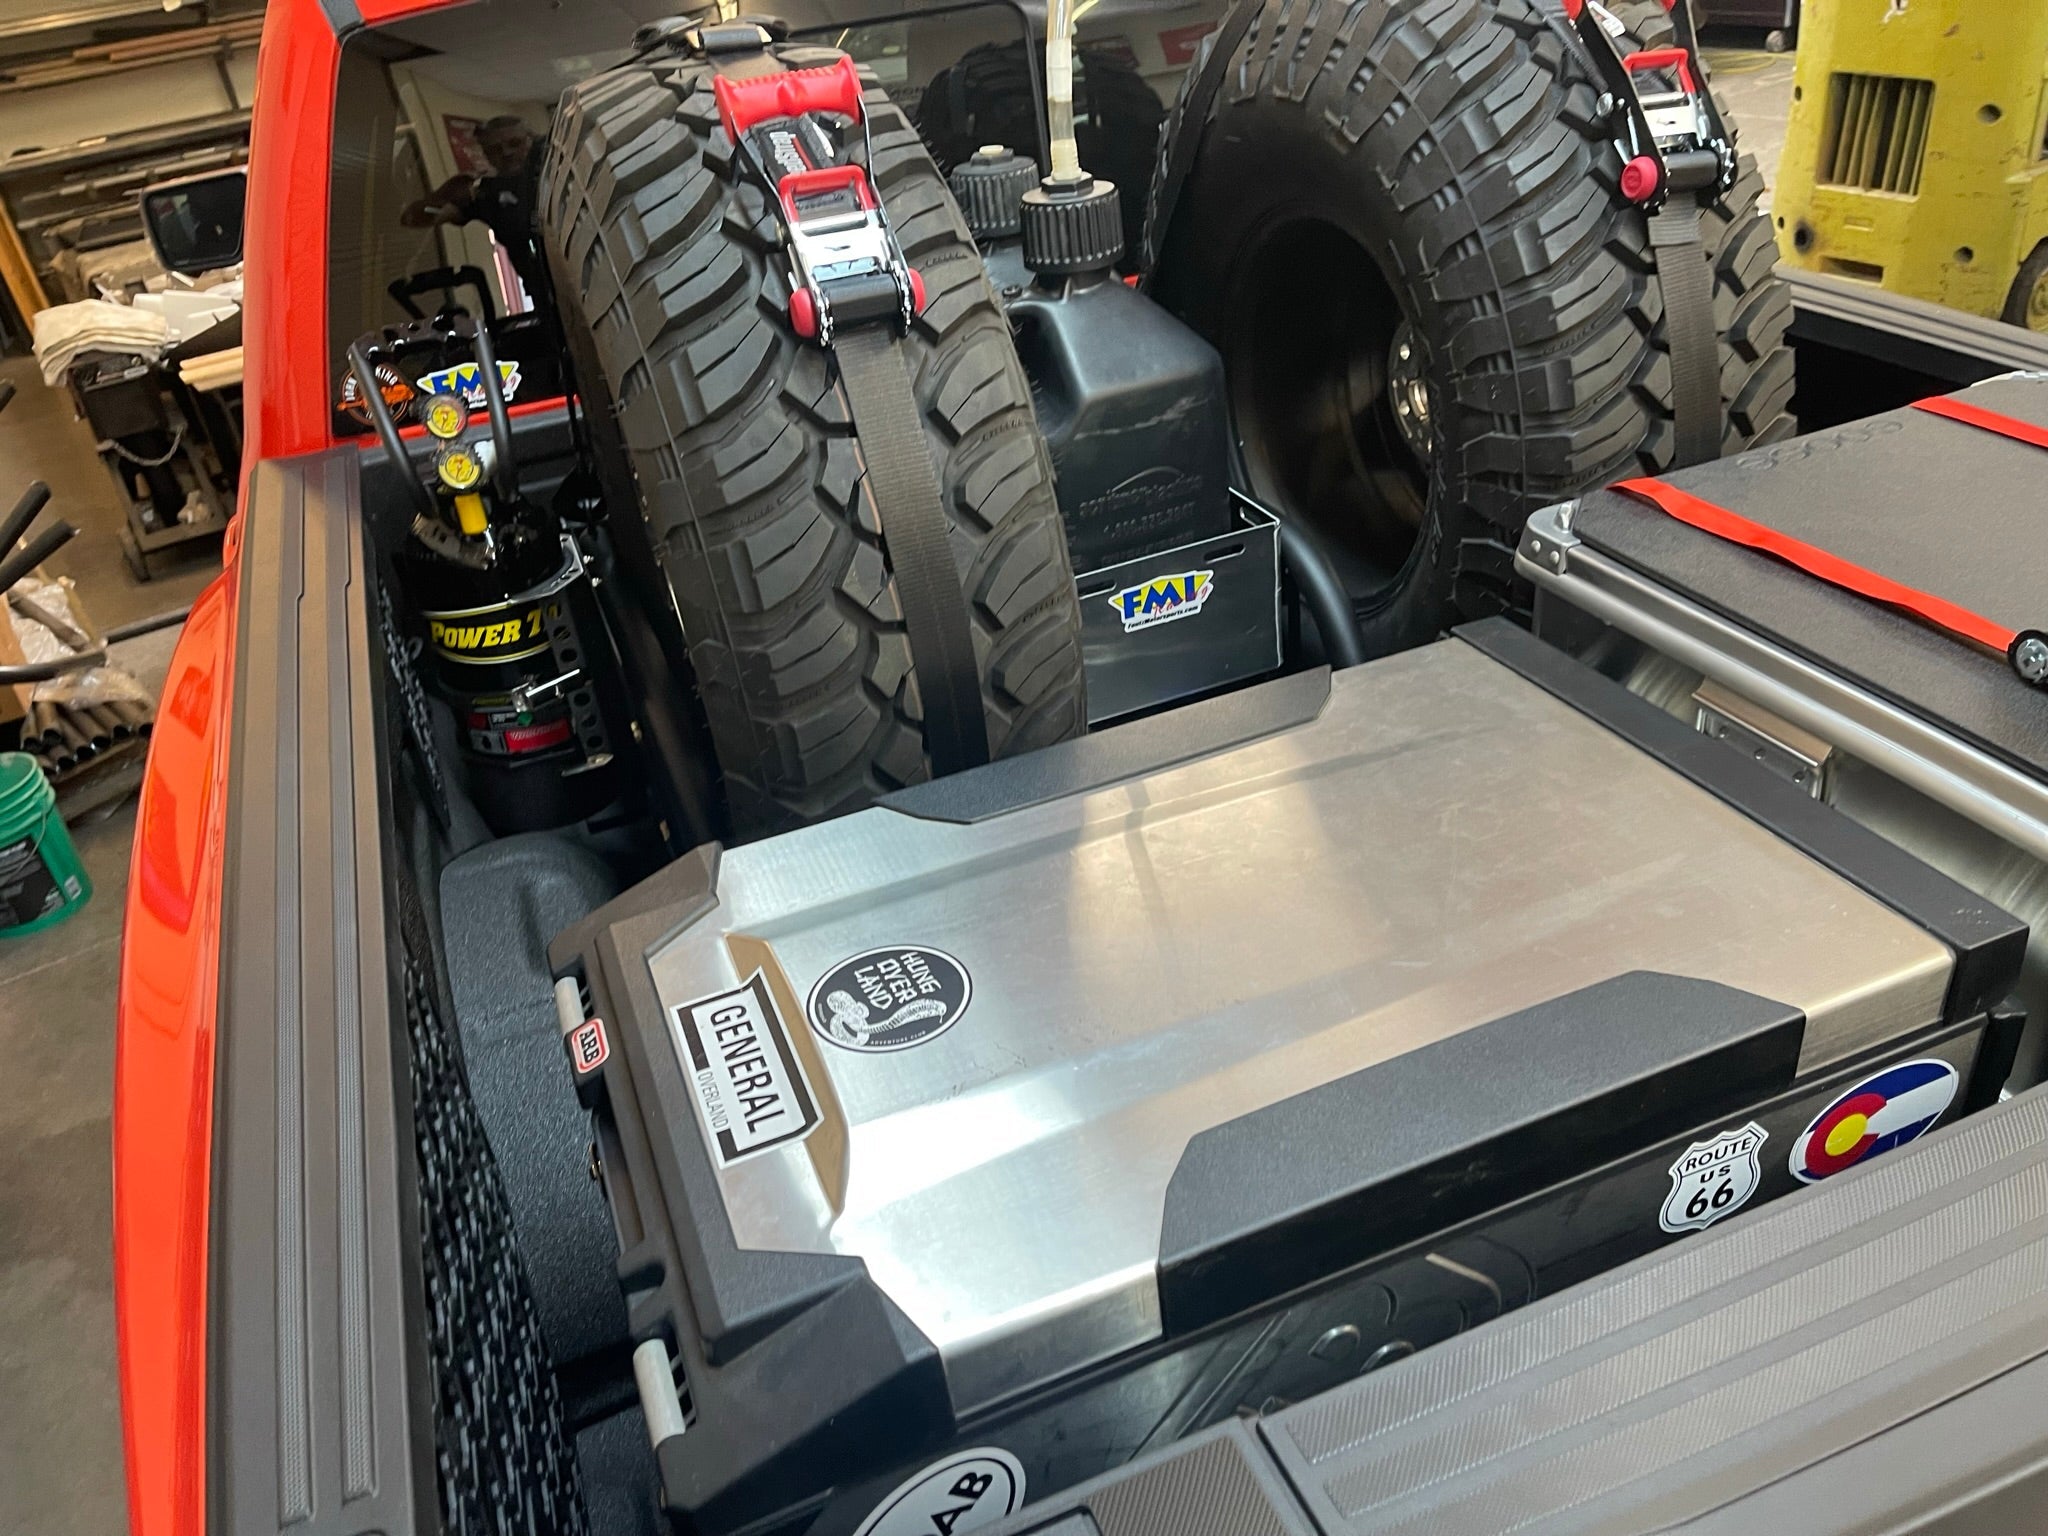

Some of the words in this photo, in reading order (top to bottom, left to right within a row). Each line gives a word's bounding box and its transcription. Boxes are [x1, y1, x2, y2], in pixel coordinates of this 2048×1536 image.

[375, 366, 398, 386] KING
[1123, 574, 1196, 620] FMI
[430, 613, 522, 649] POWER
[854, 965, 894, 1010] LAND
[877, 958, 918, 1004] OVER
[900, 952, 942, 995] HUNG
[579, 1027, 600, 1064] ARB
[870, 1035, 908, 1046] ADVENTURE
[710, 1004, 786, 1134] GENERAL
[697, 1070, 730, 1129] OVERLAND
[1685, 1136, 1753, 1172] ROUTE
[1700, 1164, 1732, 1184] US
[1685, 1177, 1734, 1218] 66
